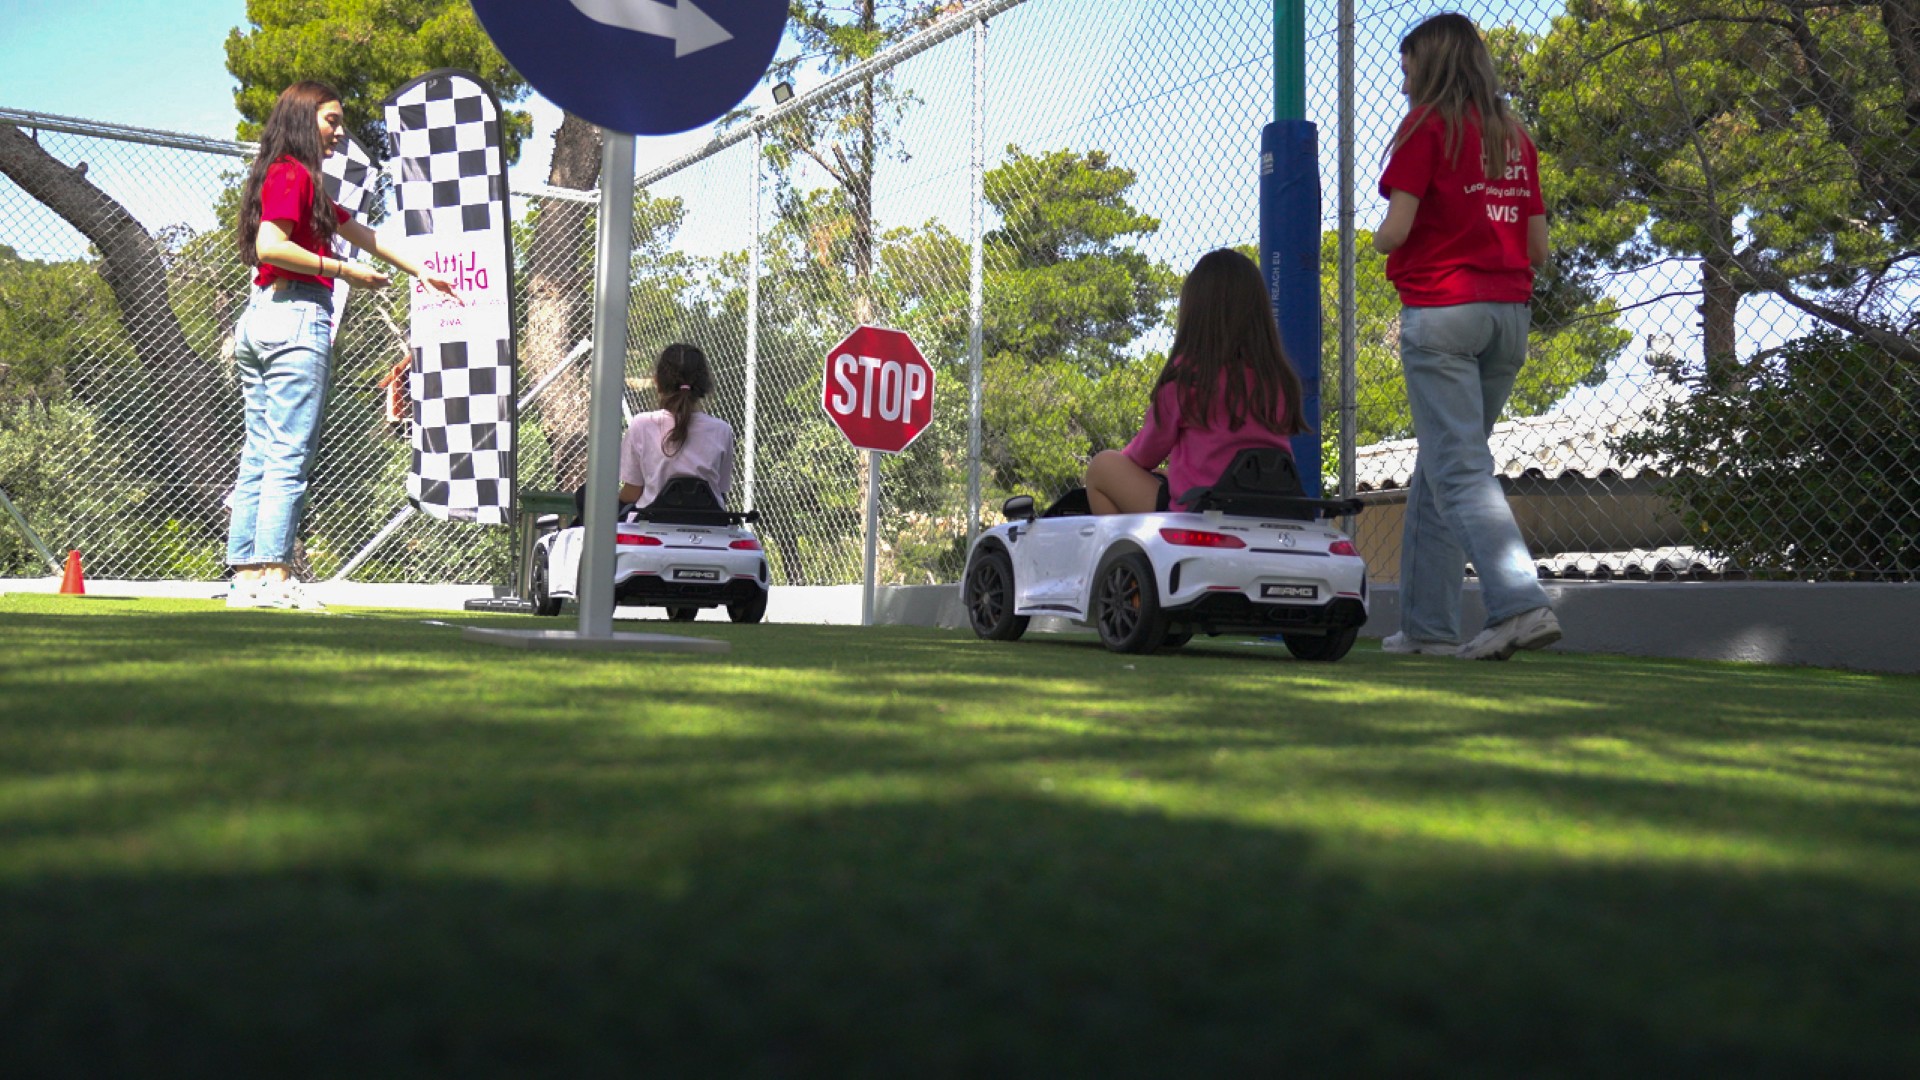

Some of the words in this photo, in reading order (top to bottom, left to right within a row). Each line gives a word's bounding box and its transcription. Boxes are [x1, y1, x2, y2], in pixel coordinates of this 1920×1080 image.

[1272, 251, 1280, 265] EU
[1271, 267, 1280, 301] REACH
[832, 353, 926, 424] STOP
